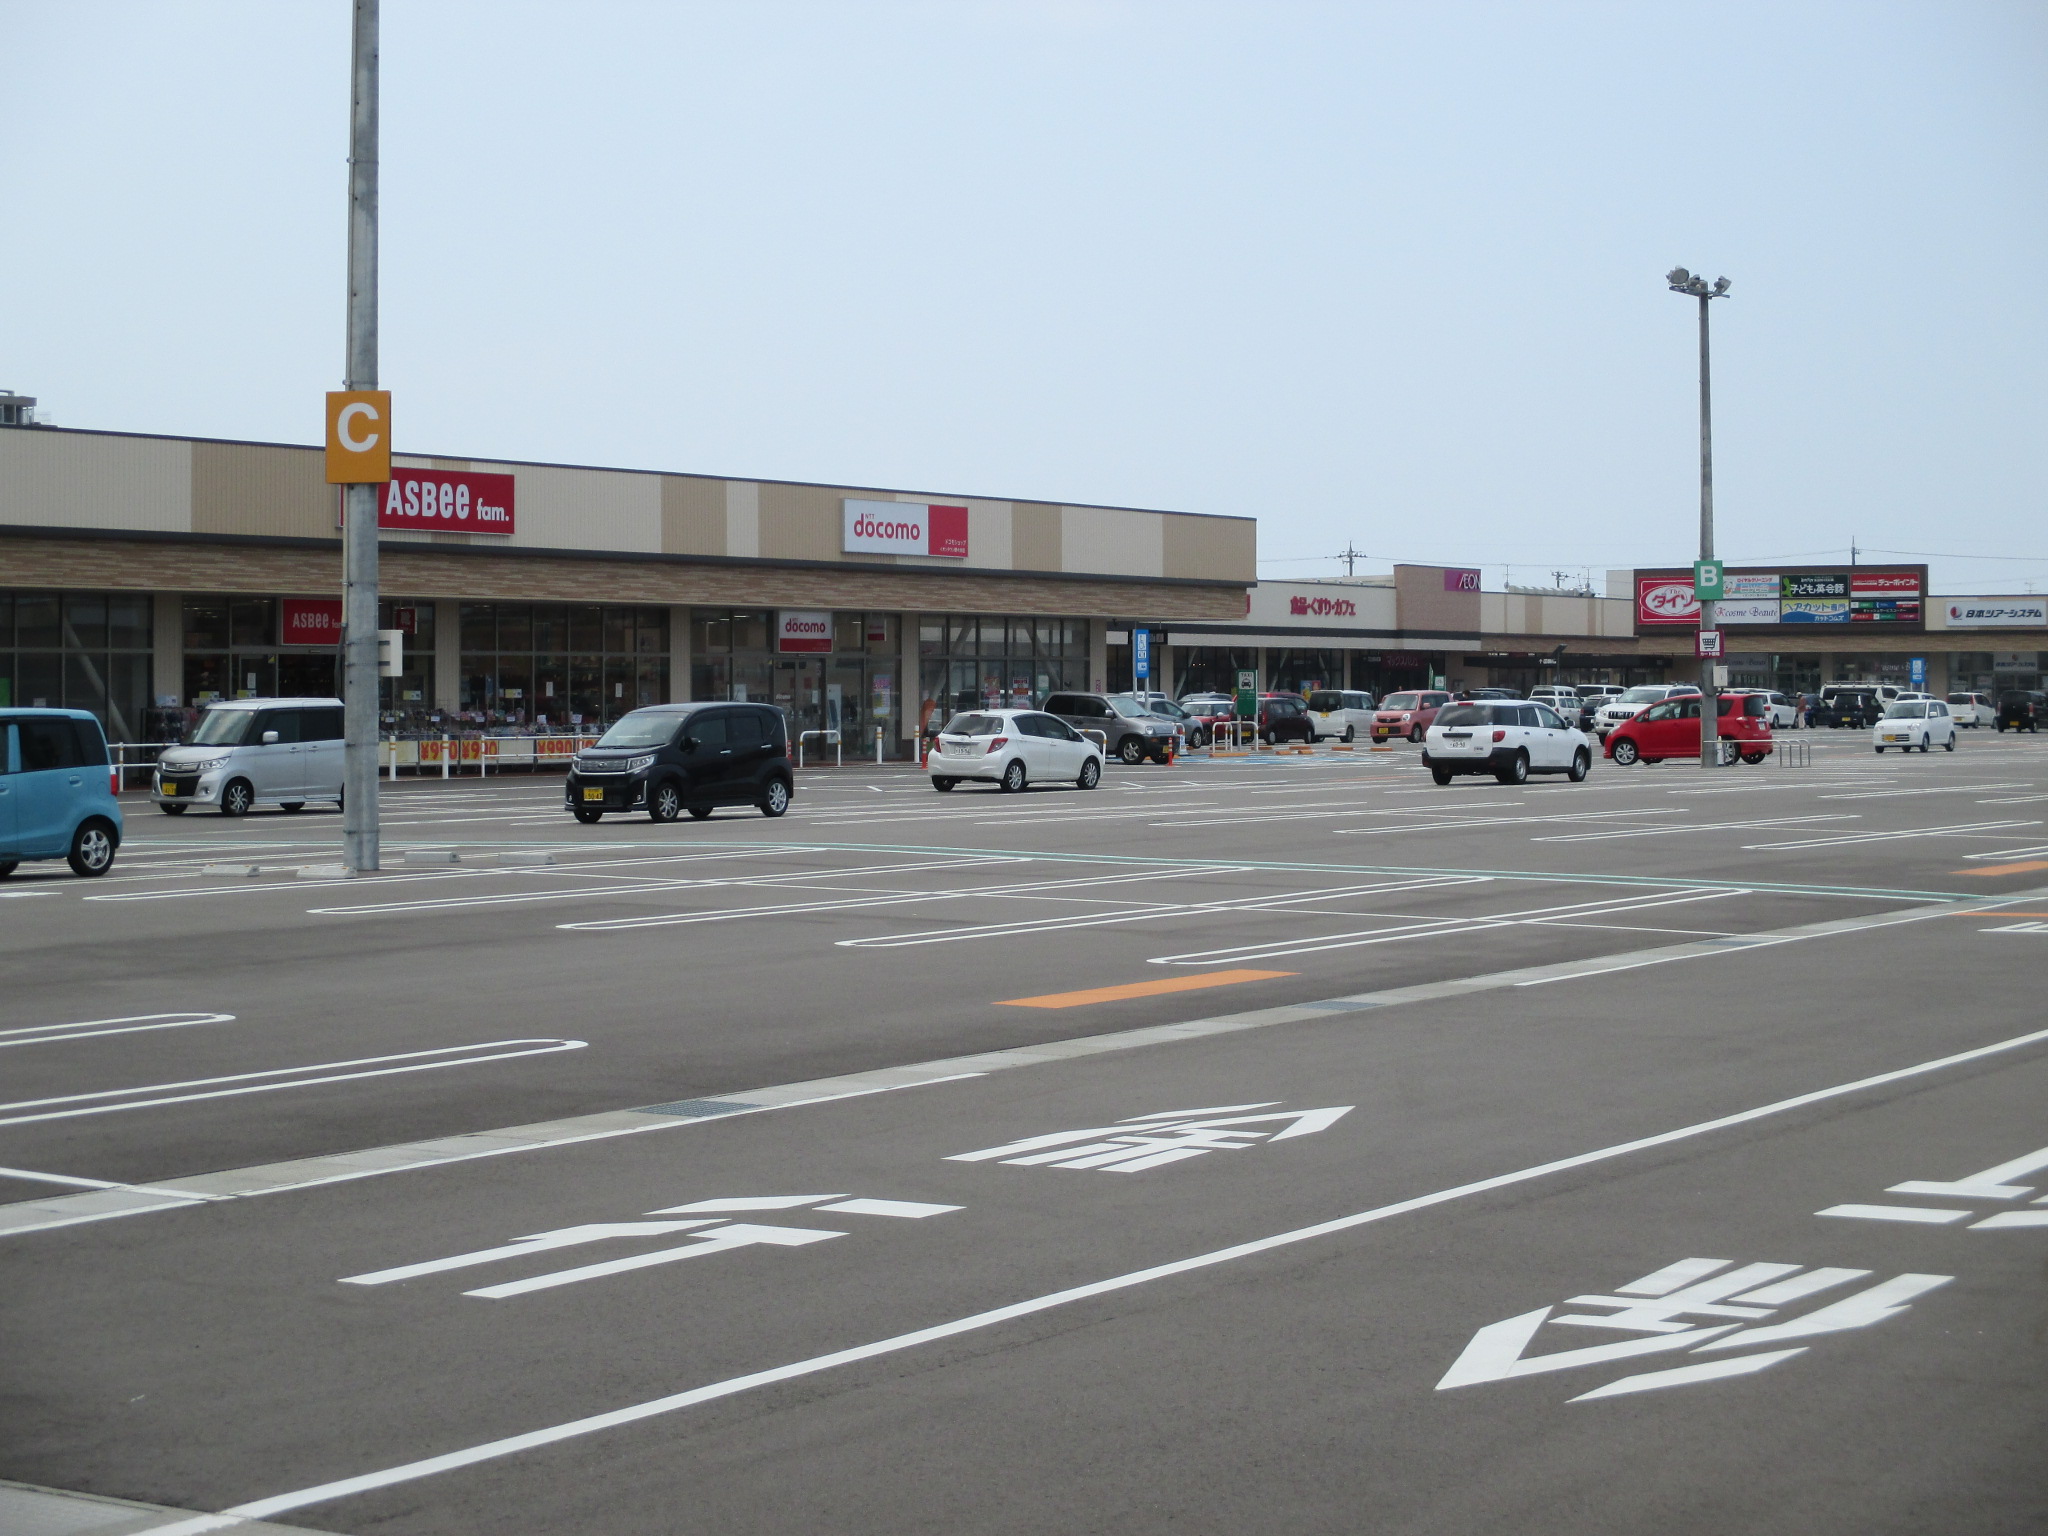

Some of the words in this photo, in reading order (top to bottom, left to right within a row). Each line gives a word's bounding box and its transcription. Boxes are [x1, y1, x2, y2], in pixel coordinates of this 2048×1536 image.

[337, 402, 379, 453] C
[385, 479, 470, 520] ASBee
[476, 497, 510, 522] fam.
[853, 513, 921, 541] docomo
[1700, 565, 1718, 587] B
[1790, 583, 1845, 594] 子ども英会話
[1651, 593, 1695, 608] ダイソ
[292, 612, 329, 629] ASBee
[1965, 609, 2042, 618] 日本ツアーシステム
[785, 617, 826, 633] docomo
